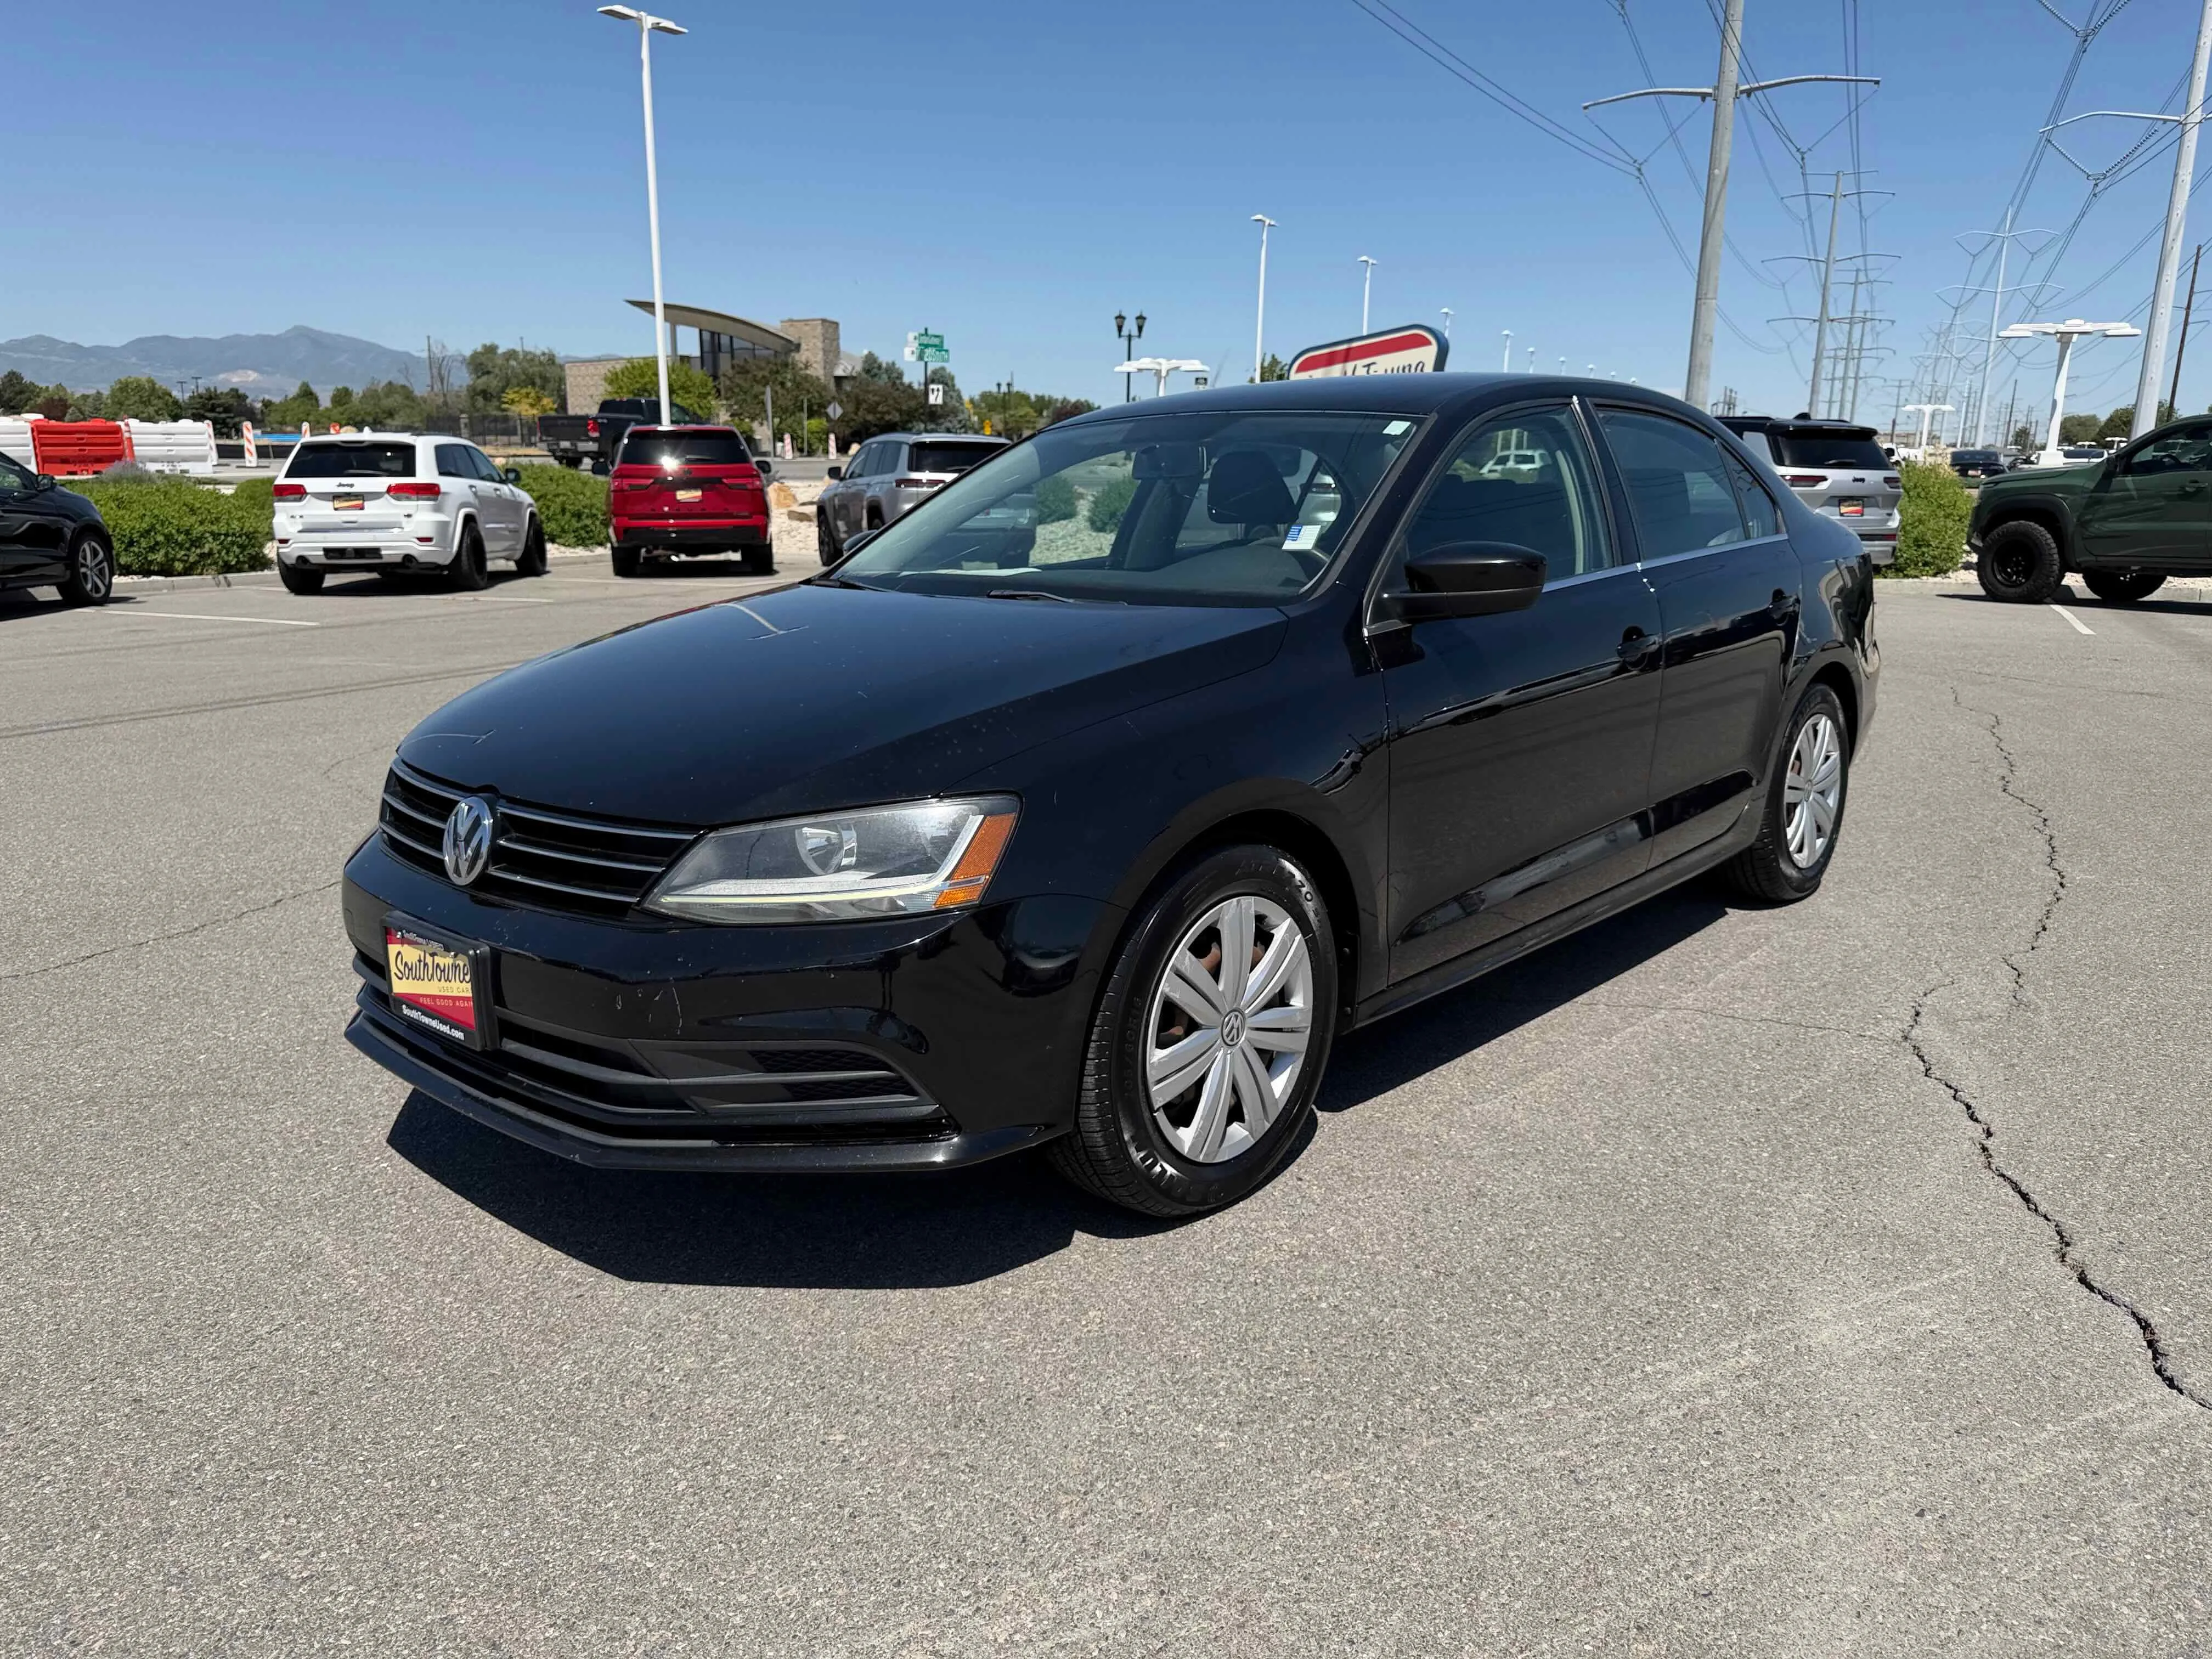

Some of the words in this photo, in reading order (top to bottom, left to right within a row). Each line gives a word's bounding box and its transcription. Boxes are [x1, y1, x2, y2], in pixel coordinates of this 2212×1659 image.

[394, 950, 472, 984] SouthTowne
[420, 997, 435, 1005] FEEL
[436, 998, 453, 1006] GOOD
